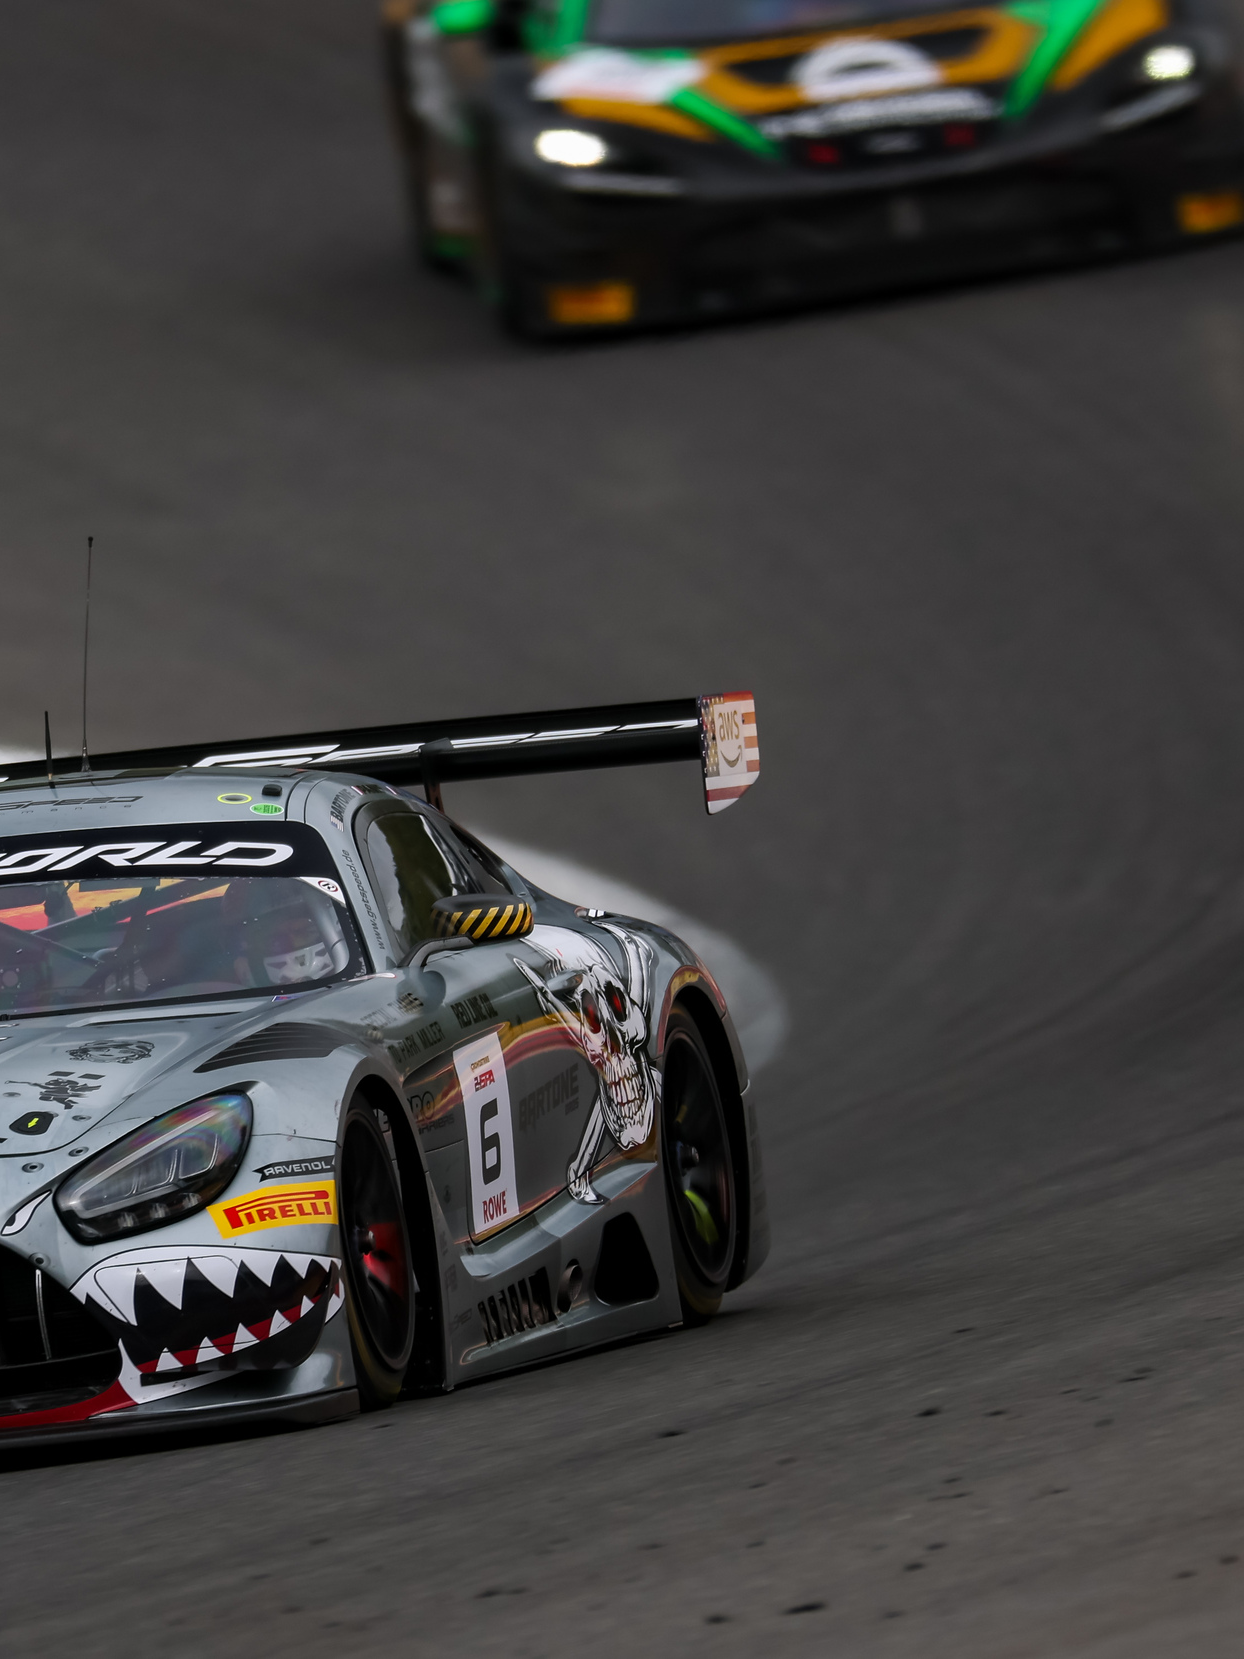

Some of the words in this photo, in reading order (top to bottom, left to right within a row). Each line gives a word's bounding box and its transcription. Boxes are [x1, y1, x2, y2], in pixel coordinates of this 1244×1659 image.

[718, 710, 740, 742] aws
[480, 1098, 501, 1186] 6
[264, 1160, 331, 1177] RAVENOL
[223, 1190, 333, 1230] PIRELLI
[482, 1191, 507, 1224] ROWE
